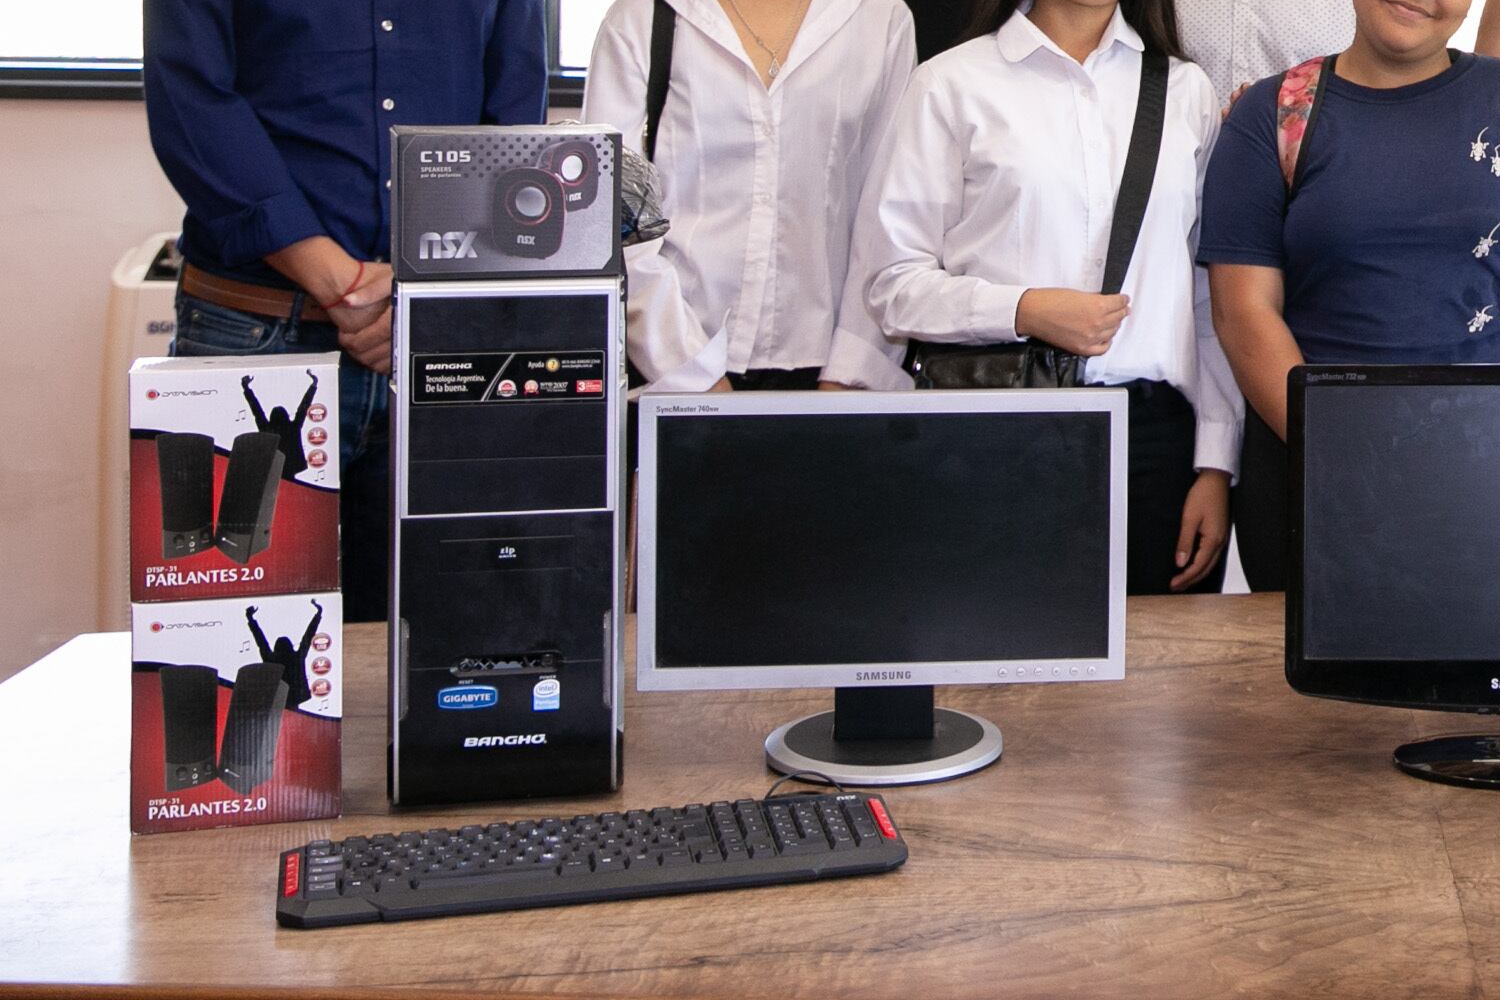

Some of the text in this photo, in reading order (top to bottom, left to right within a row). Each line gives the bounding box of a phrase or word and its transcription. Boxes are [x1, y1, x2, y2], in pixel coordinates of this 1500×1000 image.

[420, 150, 471, 163] C105
[528, 361, 545, 370] Ayuda
[425, 384, 469, 393] De la buena.
[578, 382, 586, 391] 3
[656, 405, 696, 414] SyncMaster
[146, 567, 264, 588] PARLANTES 2.0
[856, 670, 912, 681] SAMSUNG
[443, 692, 492, 703] GIGABYTE
[148, 797, 267, 820] PARLANTES 2.0
